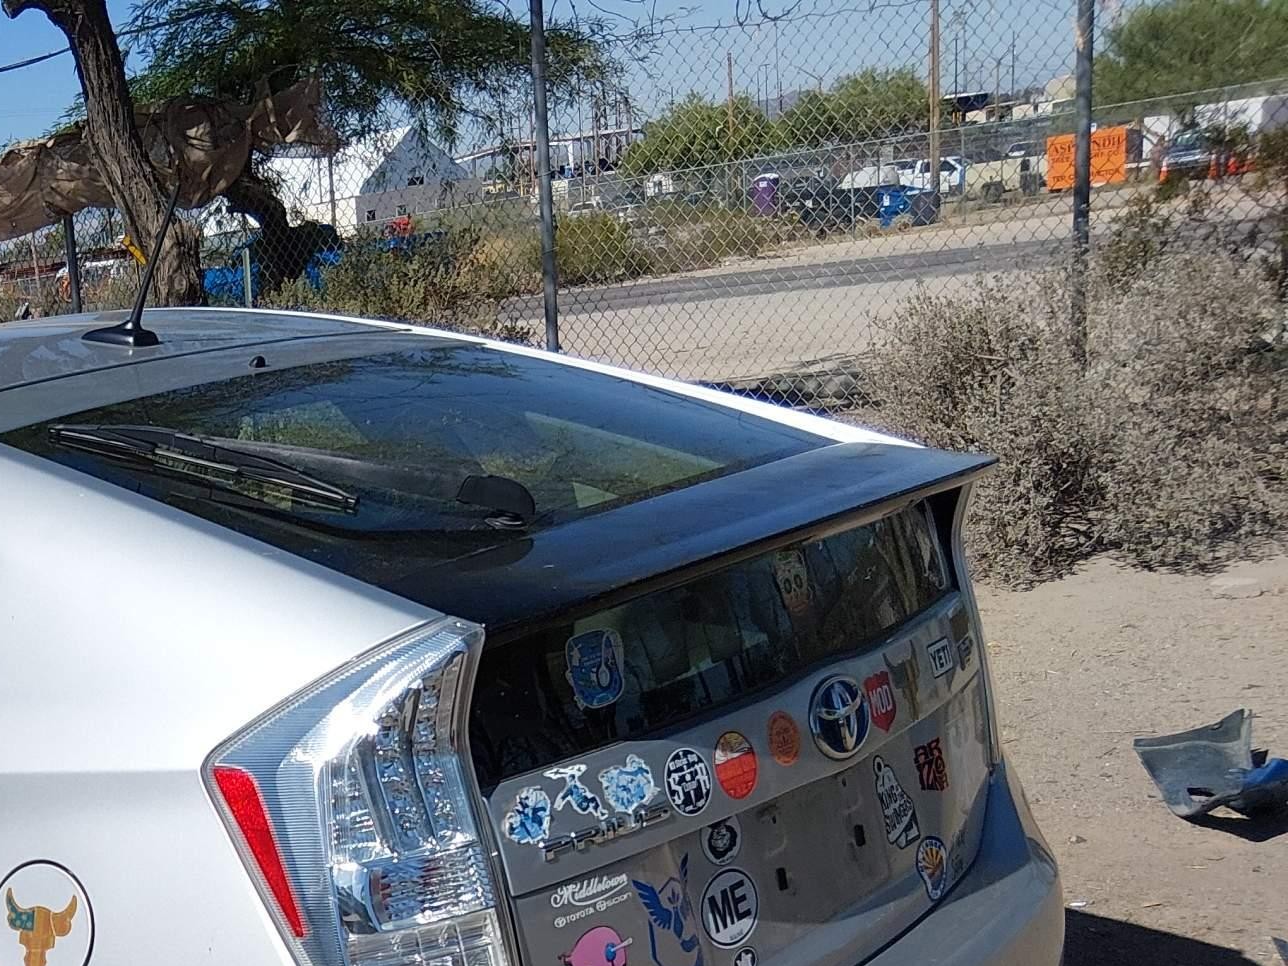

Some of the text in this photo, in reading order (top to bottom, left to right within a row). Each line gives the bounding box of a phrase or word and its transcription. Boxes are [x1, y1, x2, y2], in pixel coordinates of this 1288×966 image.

[929, 644, 952, 672] YETI
[551, 873, 628, 908] Middletown
[566, 907, 595, 923] TOYOTA
[708, 879, 752, 934] ME
